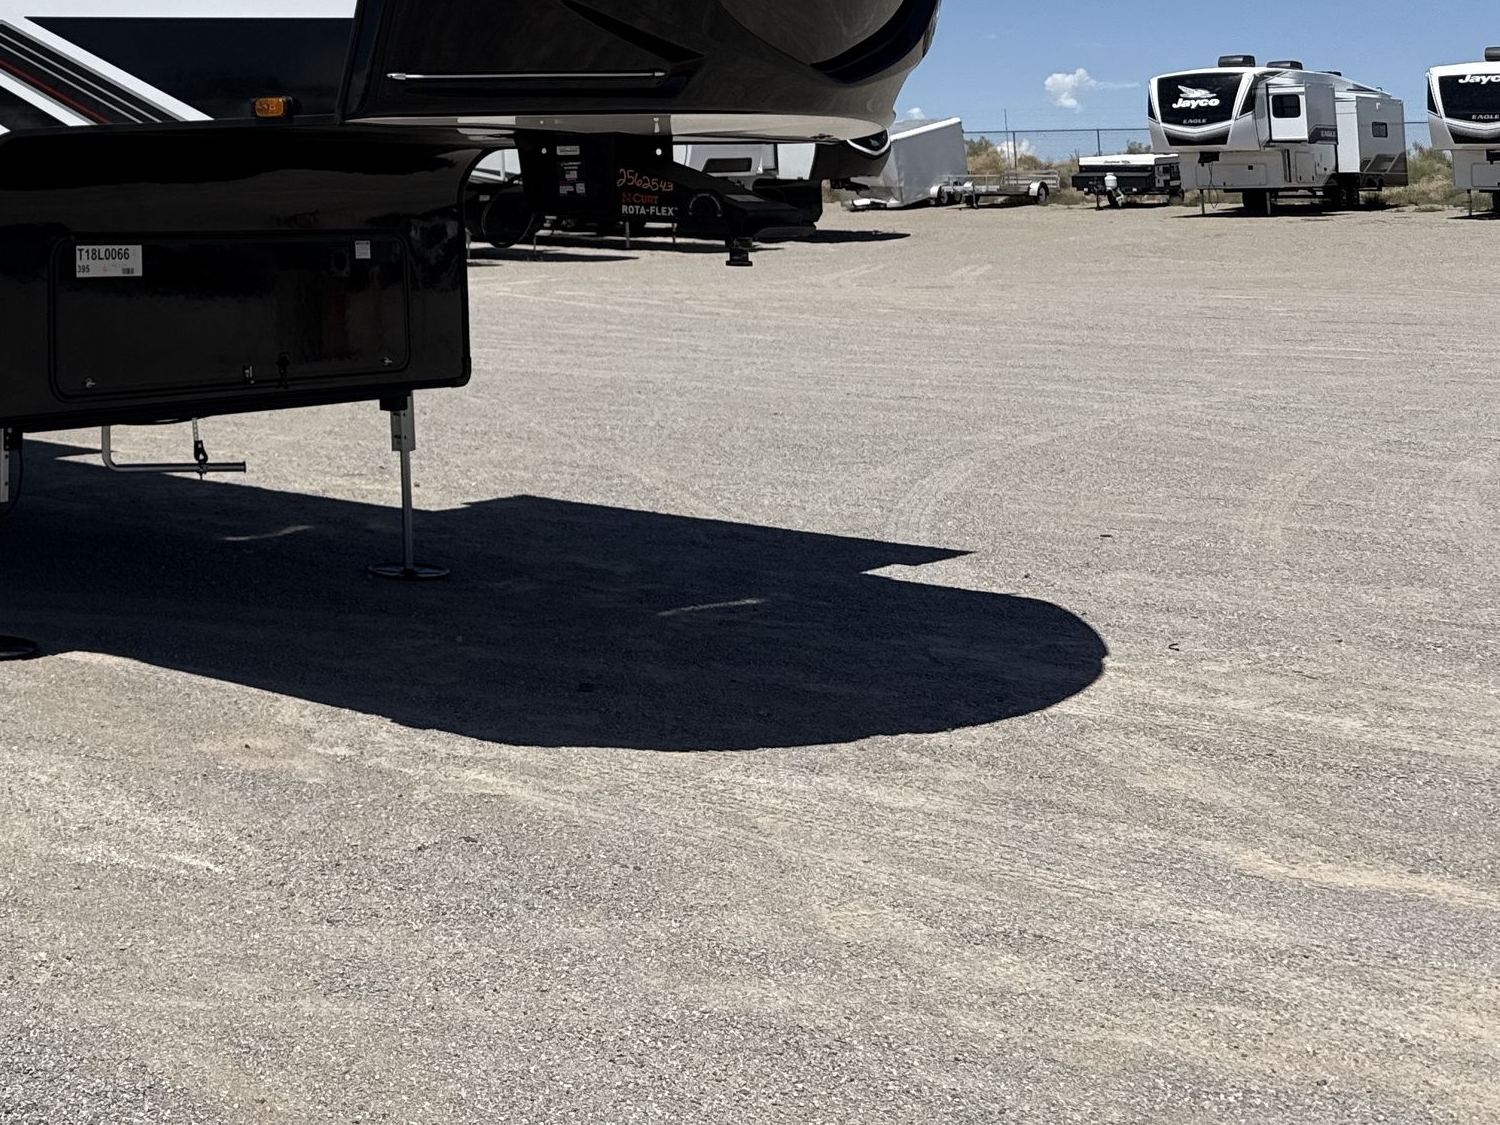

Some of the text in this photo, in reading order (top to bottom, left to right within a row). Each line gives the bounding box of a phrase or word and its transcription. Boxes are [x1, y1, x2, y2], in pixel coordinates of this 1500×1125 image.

[1172, 97, 1221, 110] Jayco
[616, 168, 674, 192] 2562543
[632, 193, 659, 205] CURT
[77, 247, 131, 262] T18L0066
